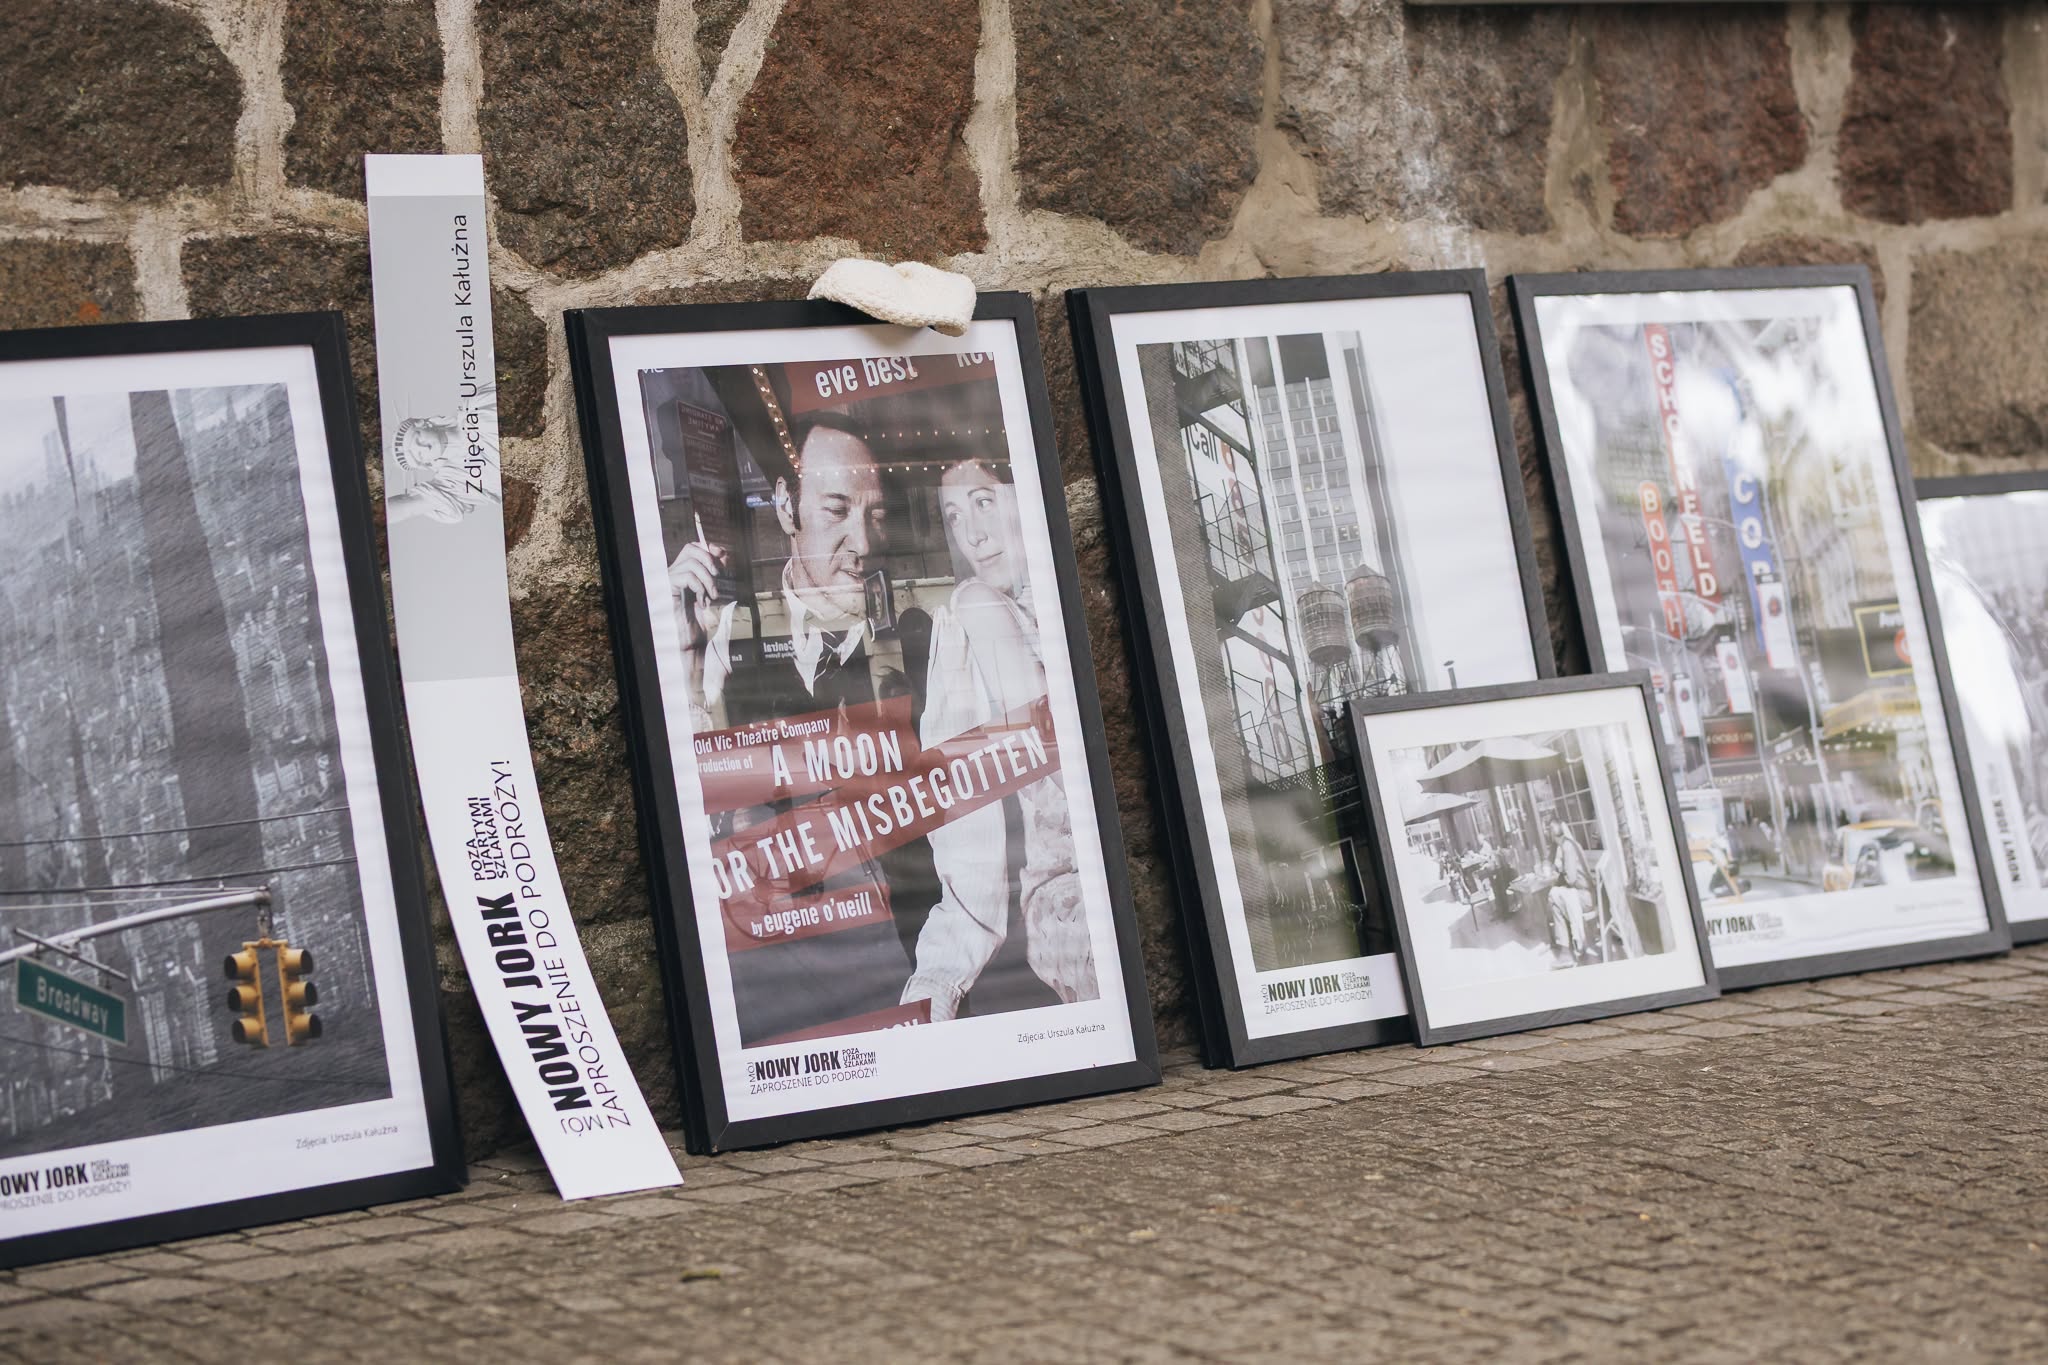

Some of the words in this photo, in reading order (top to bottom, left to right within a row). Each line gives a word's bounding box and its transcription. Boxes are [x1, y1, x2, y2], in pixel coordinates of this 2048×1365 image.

[451, 213, 472, 306] Kałużna
[456, 314, 477, 399] Urszula
[815, 364, 859, 398] eve
[861, 355, 919, 388] best
[462, 405, 484, 494] Zdjęcia:
[694, 738, 713, 756] Old
[714, 735, 733, 752] Vic
[734, 727, 779, 748] Theatre
[781, 718, 830, 739] Company
[772, 744, 794, 787] A
[804, 730, 903, 783] MOON
[699, 758, 743, 774] roduction
[743, 755, 754, 770] of
[756, 821, 825, 880] THE
[827, 725, 1049, 853] MISBEGOTTEN
[467, 797, 497, 881] UTARTYMI
[479, 797, 509, 879] SZLAKAMI
[490, 760, 542, 898] PODRÓŻY!
[466, 838, 486, 881] POZA
[528, 909, 558, 949] DO
[751, 920, 764, 937] by
[763, 909, 820, 935] eugene
[823, 892, 873, 922] o'neill
[476, 891, 544, 989] JORK
[37, 975, 109, 1033] Broadway
[1267, 979, 1306, 1002] NOWY
[1309, 974, 1342, 996] JORK
[1319, 996, 1332, 1007] DO
[510, 1000, 593, 1112] NOWY
[543, 957, 632, 1128] ZAPROSZENIE
[842, 1047, 860, 1056] POZA
[843, 1051, 876, 1063] UTARTYMI
[843, 1058, 877, 1069] SZLAKAMI
[750, 1076, 813, 1095] ZAPROSZENIE
[815, 1074, 830, 1086] DO
[755, 1056, 800, 1081] NOWY
[804, 1050, 841, 1074] JORK
[0, 1170, 40, 1197] OWY
[45, 1163, 89, 1190] JORK
